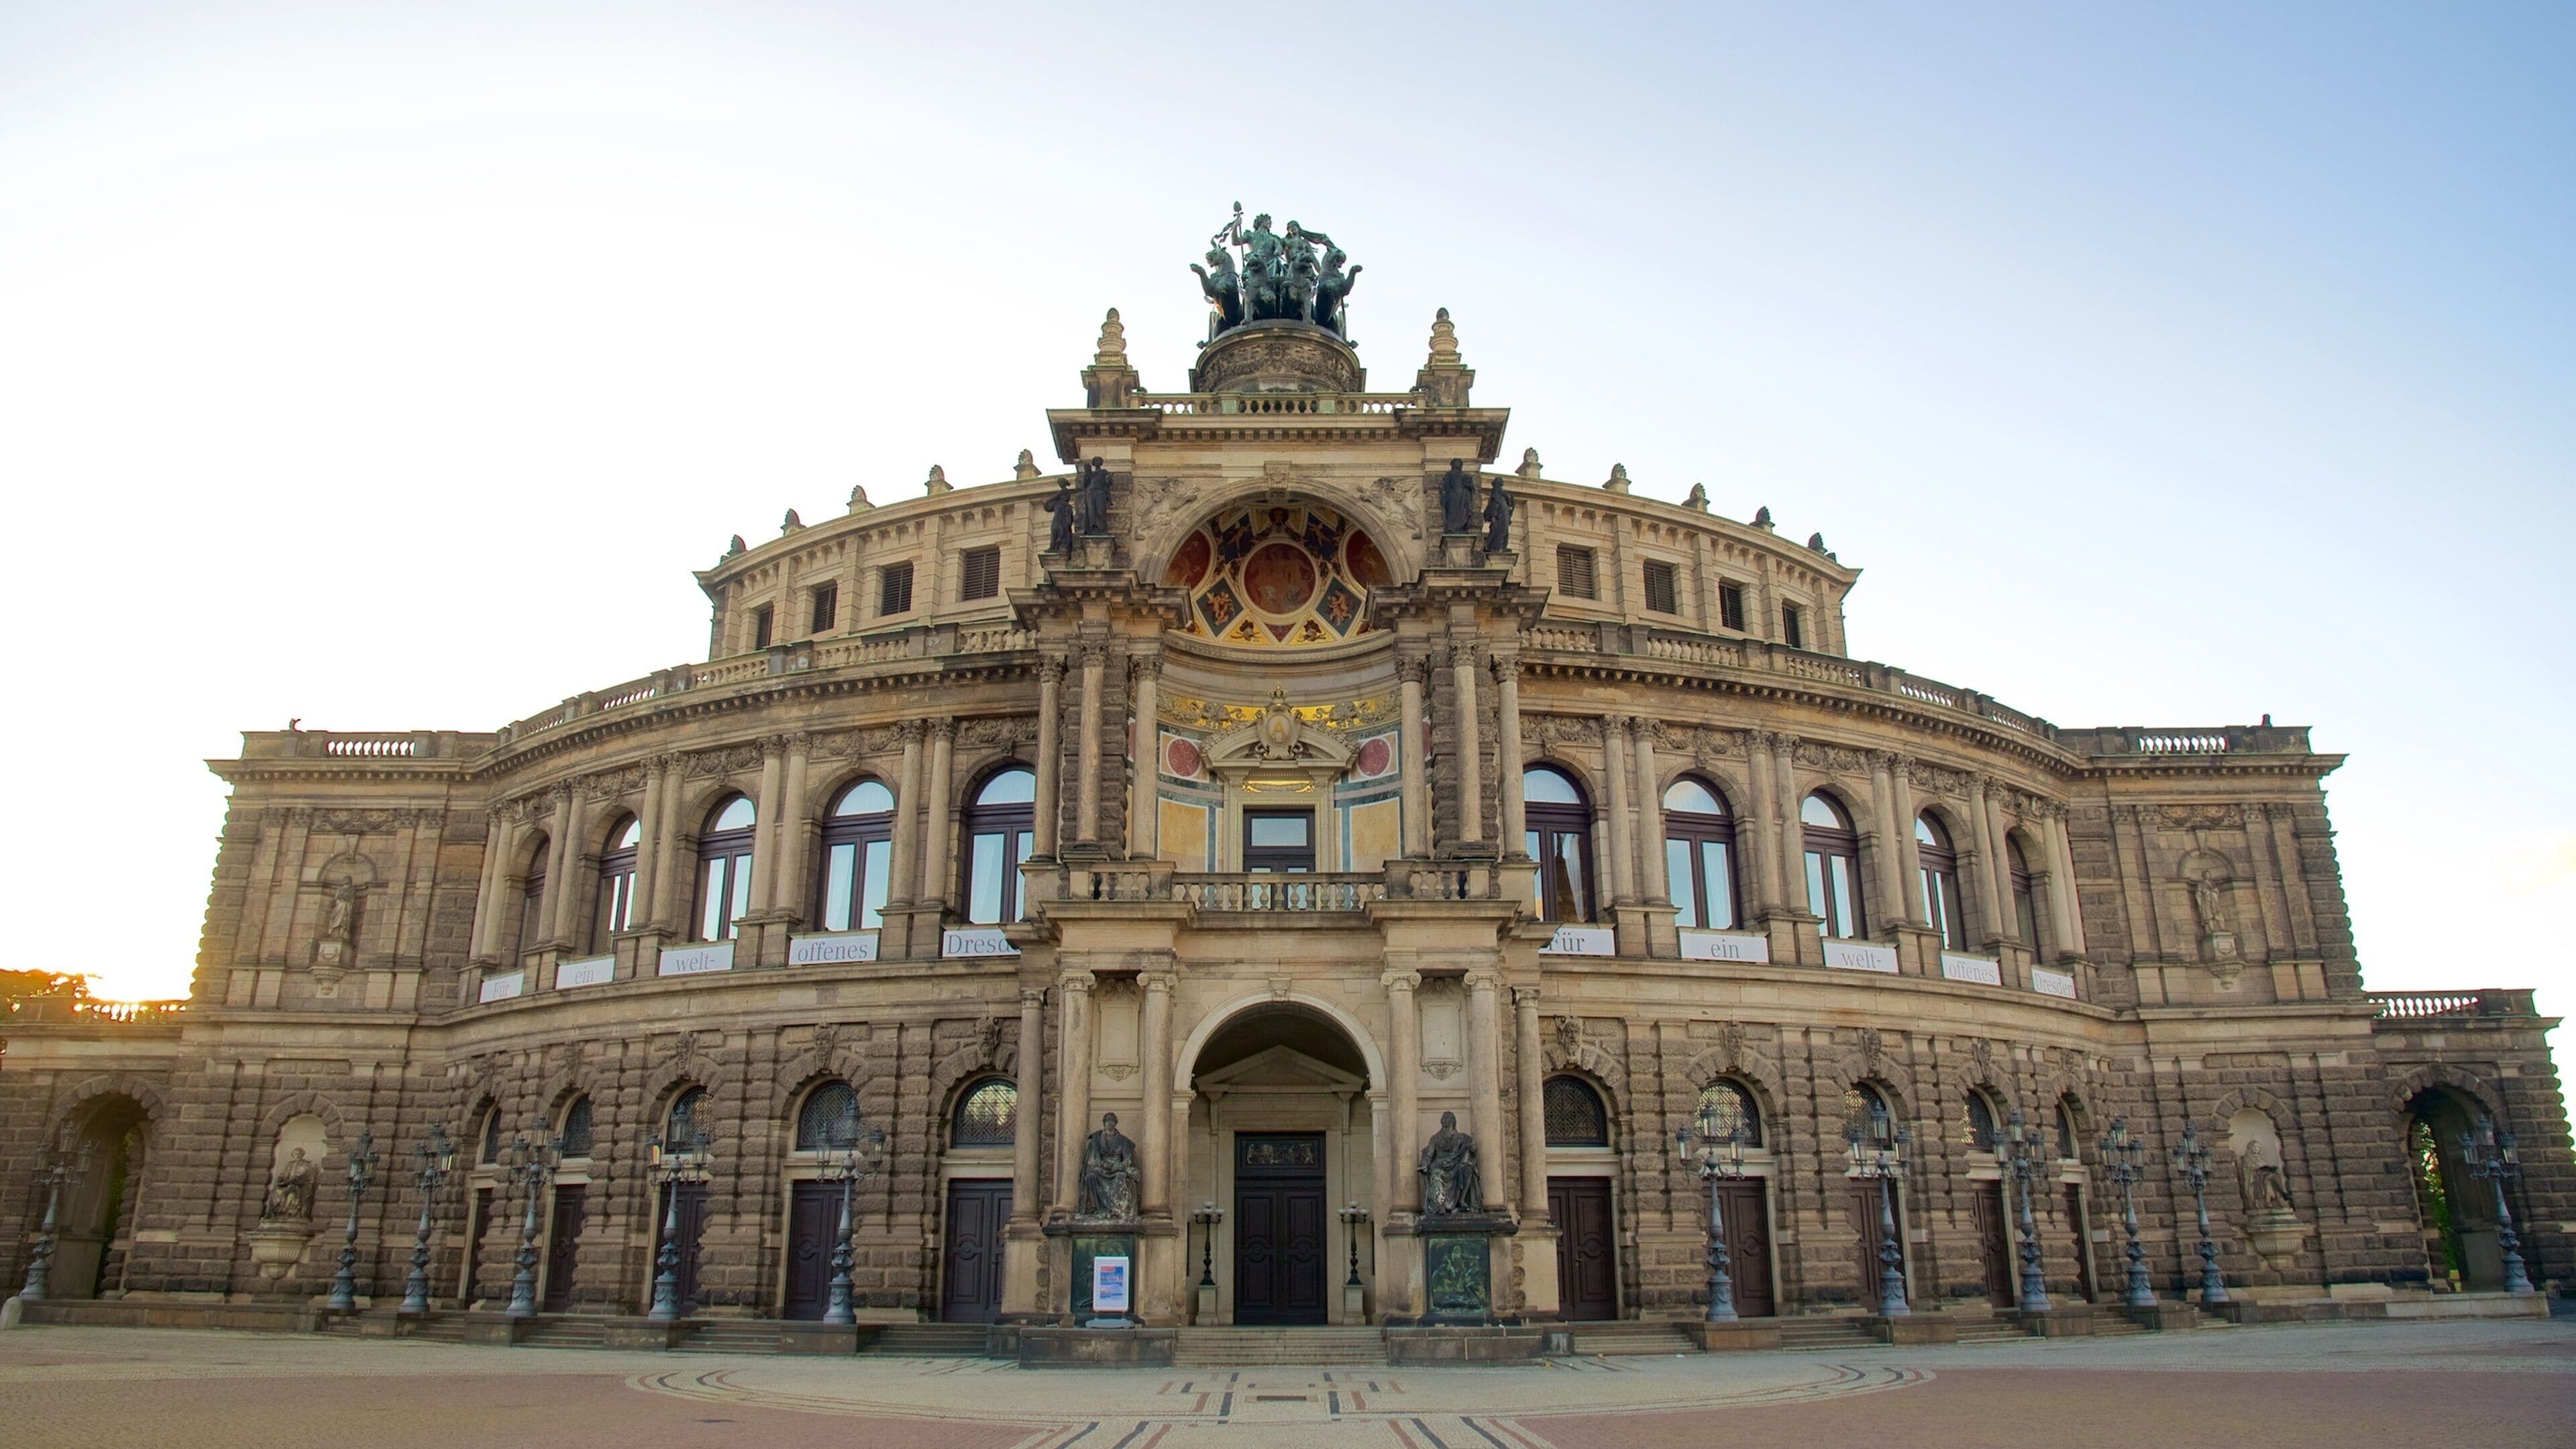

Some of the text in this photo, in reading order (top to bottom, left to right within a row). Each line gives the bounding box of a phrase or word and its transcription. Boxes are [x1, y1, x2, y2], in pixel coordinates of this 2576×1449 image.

[798, 942, 867, 961] offenes
[1711, 939, 1739, 959] ein
[676, 952, 716, 971] welt-
[1841, 950, 1881, 969] welt-
[575, 966, 594, 984] ein
[1949, 961, 1995, 982] offenes
[493, 981, 510, 998] Für
[2035, 973, 2074, 996] Dresden
